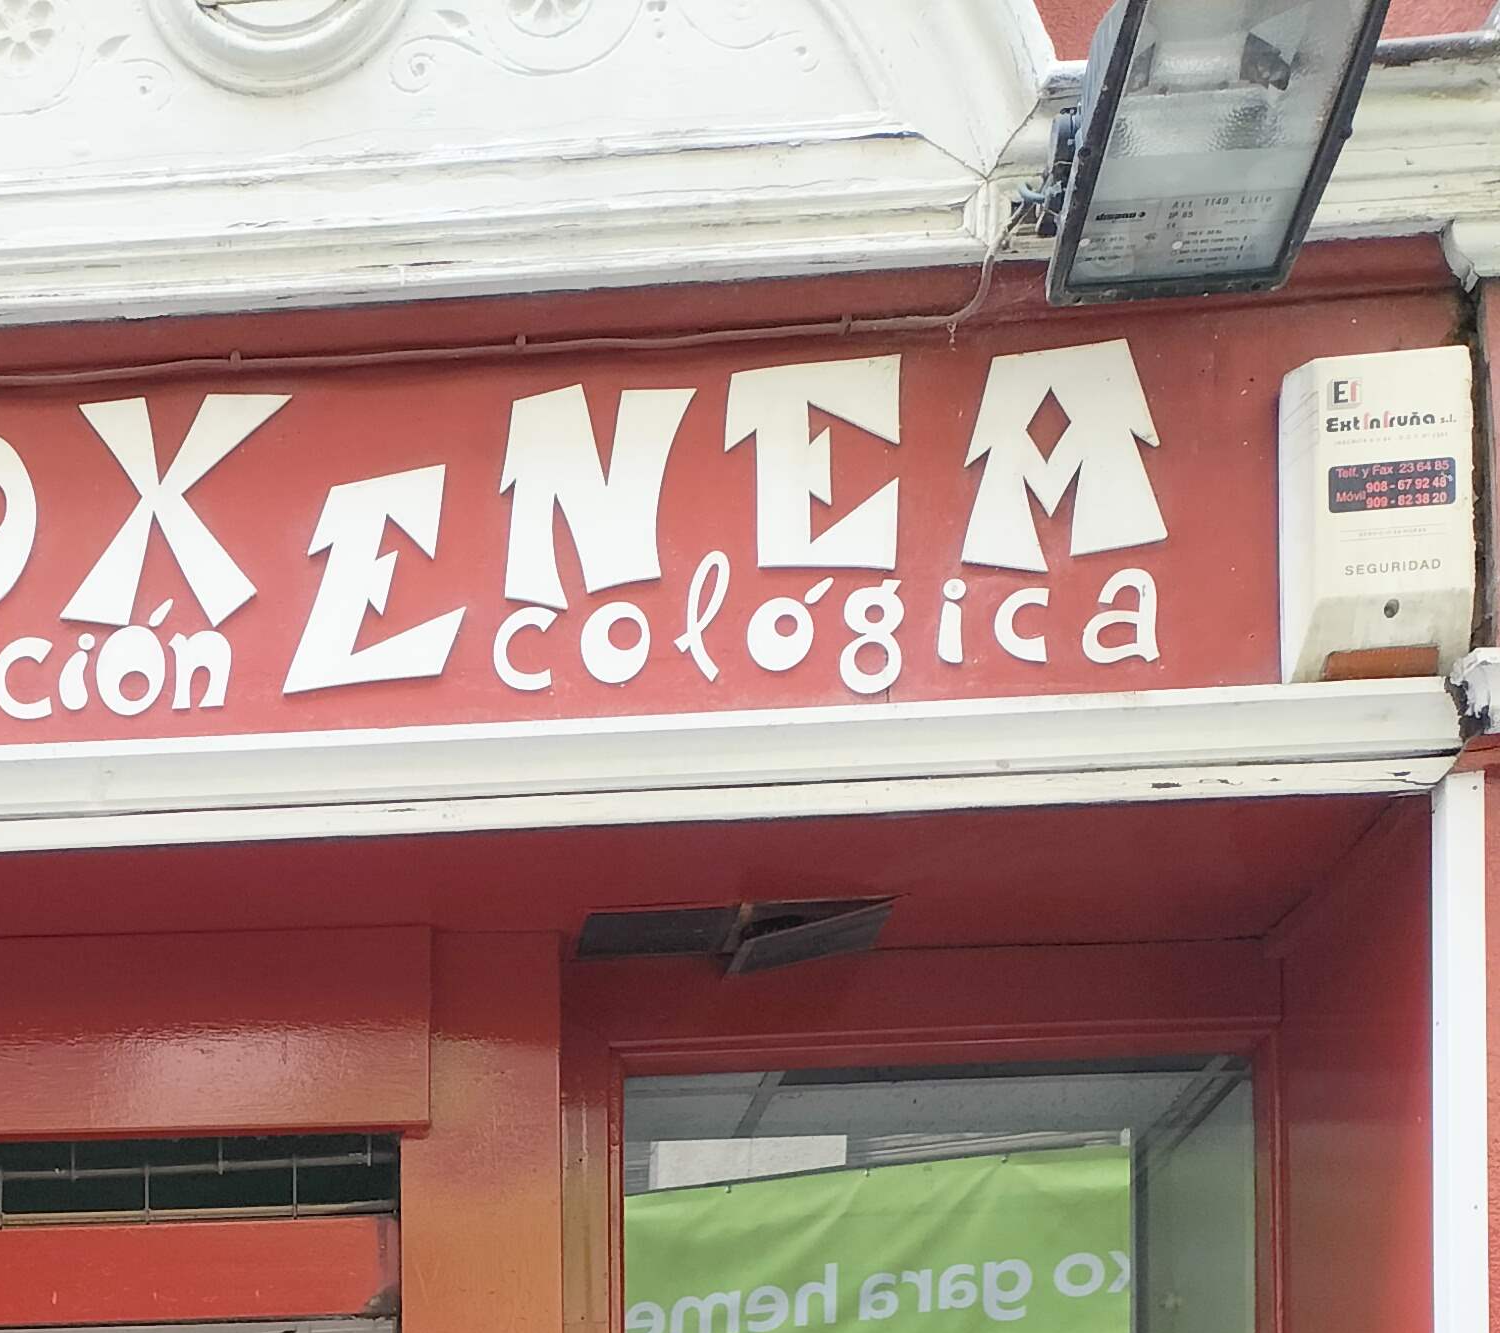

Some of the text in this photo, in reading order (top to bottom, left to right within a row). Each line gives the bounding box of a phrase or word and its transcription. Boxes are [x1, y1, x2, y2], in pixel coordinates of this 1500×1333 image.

[1372, 464, 1394, 476] Fax
[1398, 462, 1414, 474] 23
[1416, 461, 1432, 472] 64
[1414, 477, 1430, 489] 92
[1335, 491, 1367, 503] Móvil
[1431, 491, 1448, 503] 20
[1344, 558, 1441, 576] SEGURIDAD
